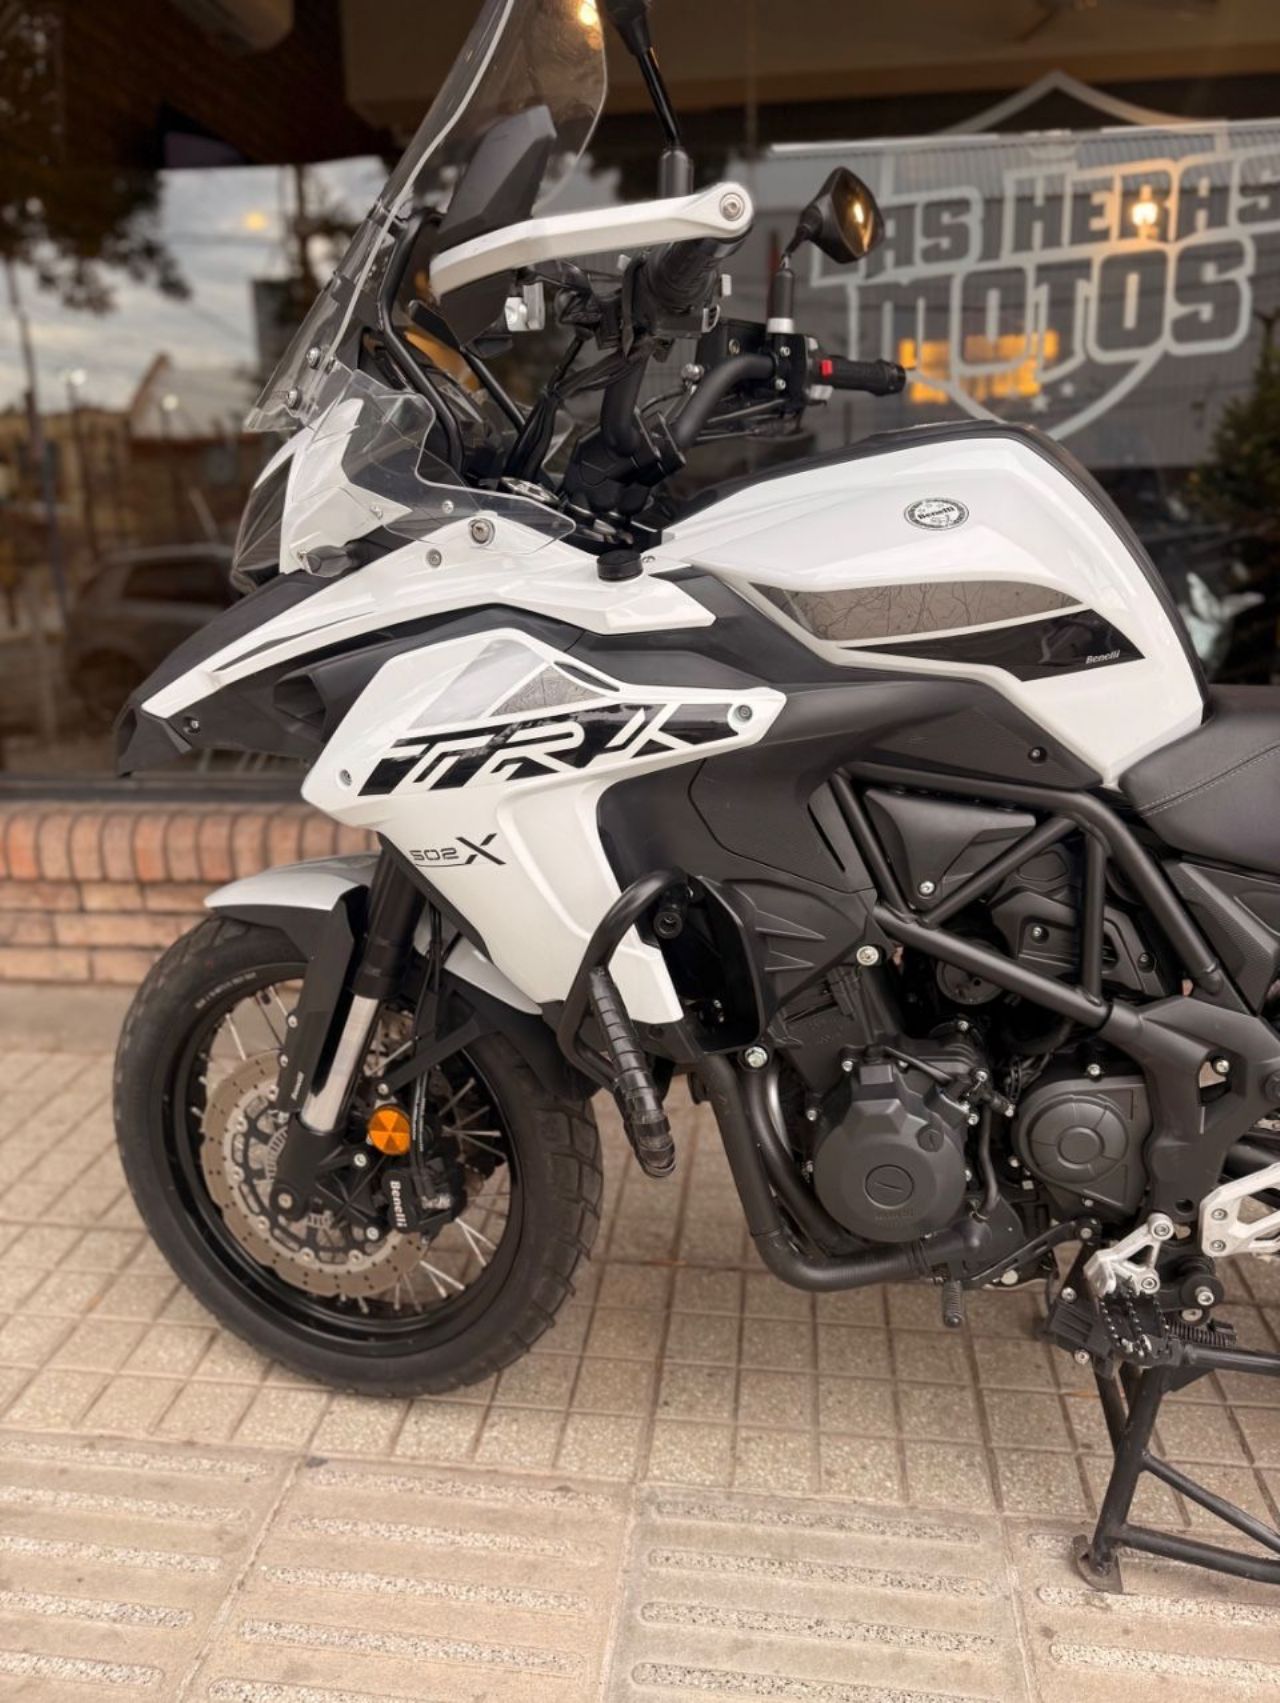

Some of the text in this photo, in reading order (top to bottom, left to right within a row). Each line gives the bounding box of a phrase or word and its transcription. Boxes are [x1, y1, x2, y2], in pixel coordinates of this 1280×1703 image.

[1008, 149, 1280, 256] HERAS
[850, 237, 1250, 380] MOTOS
[1085, 650, 1121, 664] Benelli
[376, 702, 700, 796] TRK
[390, 1180, 408, 1228] Benelli
